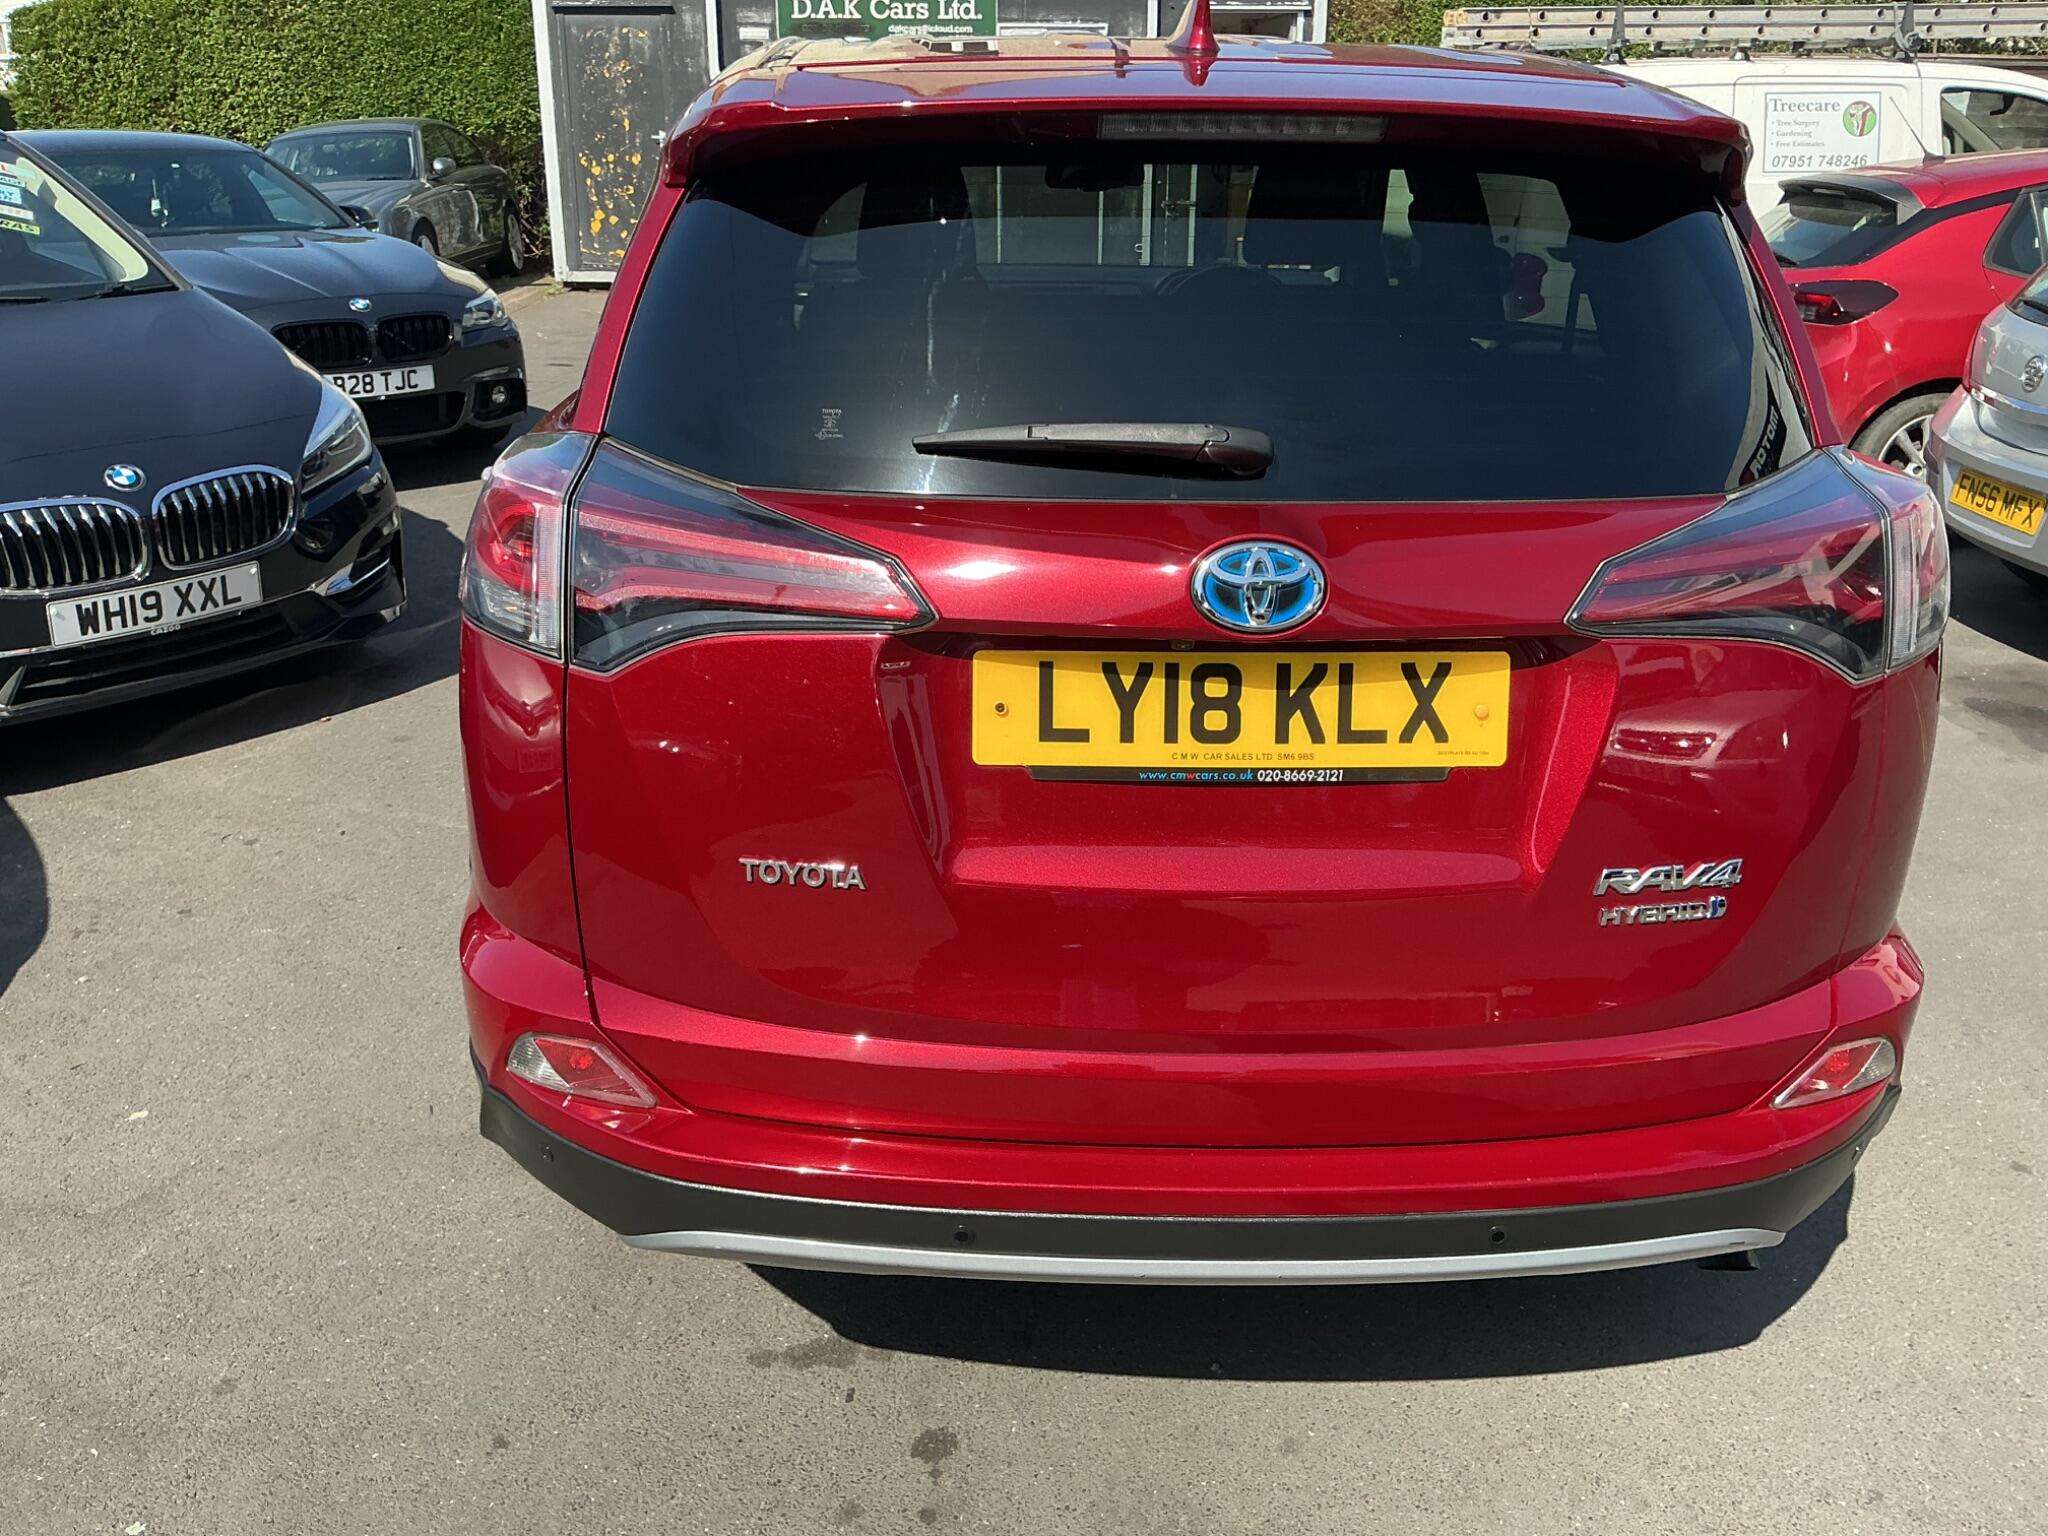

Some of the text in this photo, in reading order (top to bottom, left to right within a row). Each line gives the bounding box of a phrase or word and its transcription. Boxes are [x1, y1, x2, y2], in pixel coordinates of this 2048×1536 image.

[791, 0, 983, 20] D.A.K Cars Ltd.
[1769, 98, 1841, 112] Treecare
[1776, 130, 1812, 138] Gardening
[1772, 154, 1868, 168] 07951 748246
[381, 369, 419, 392] TJC
[1956, 473, 2041, 528] FN56 MFX
[76, 574, 242, 636] WH19 XXL
[1038, 661, 1453, 745] LY18 KLX
[1203, 752, 1222, 761] CAR
[1225, 752, 1254, 761] SALES
[1256, 752, 1273, 761] LTD
[1277, 752, 1295, 760] SM6
[1139, 768, 1344, 782] www.cmwcars.co.uk 020-8669-2121
[738, 856, 867, 890] TOYOTA
[1593, 857, 1743, 896] RAV4
[1599, 901, 1708, 926] HYBRID
